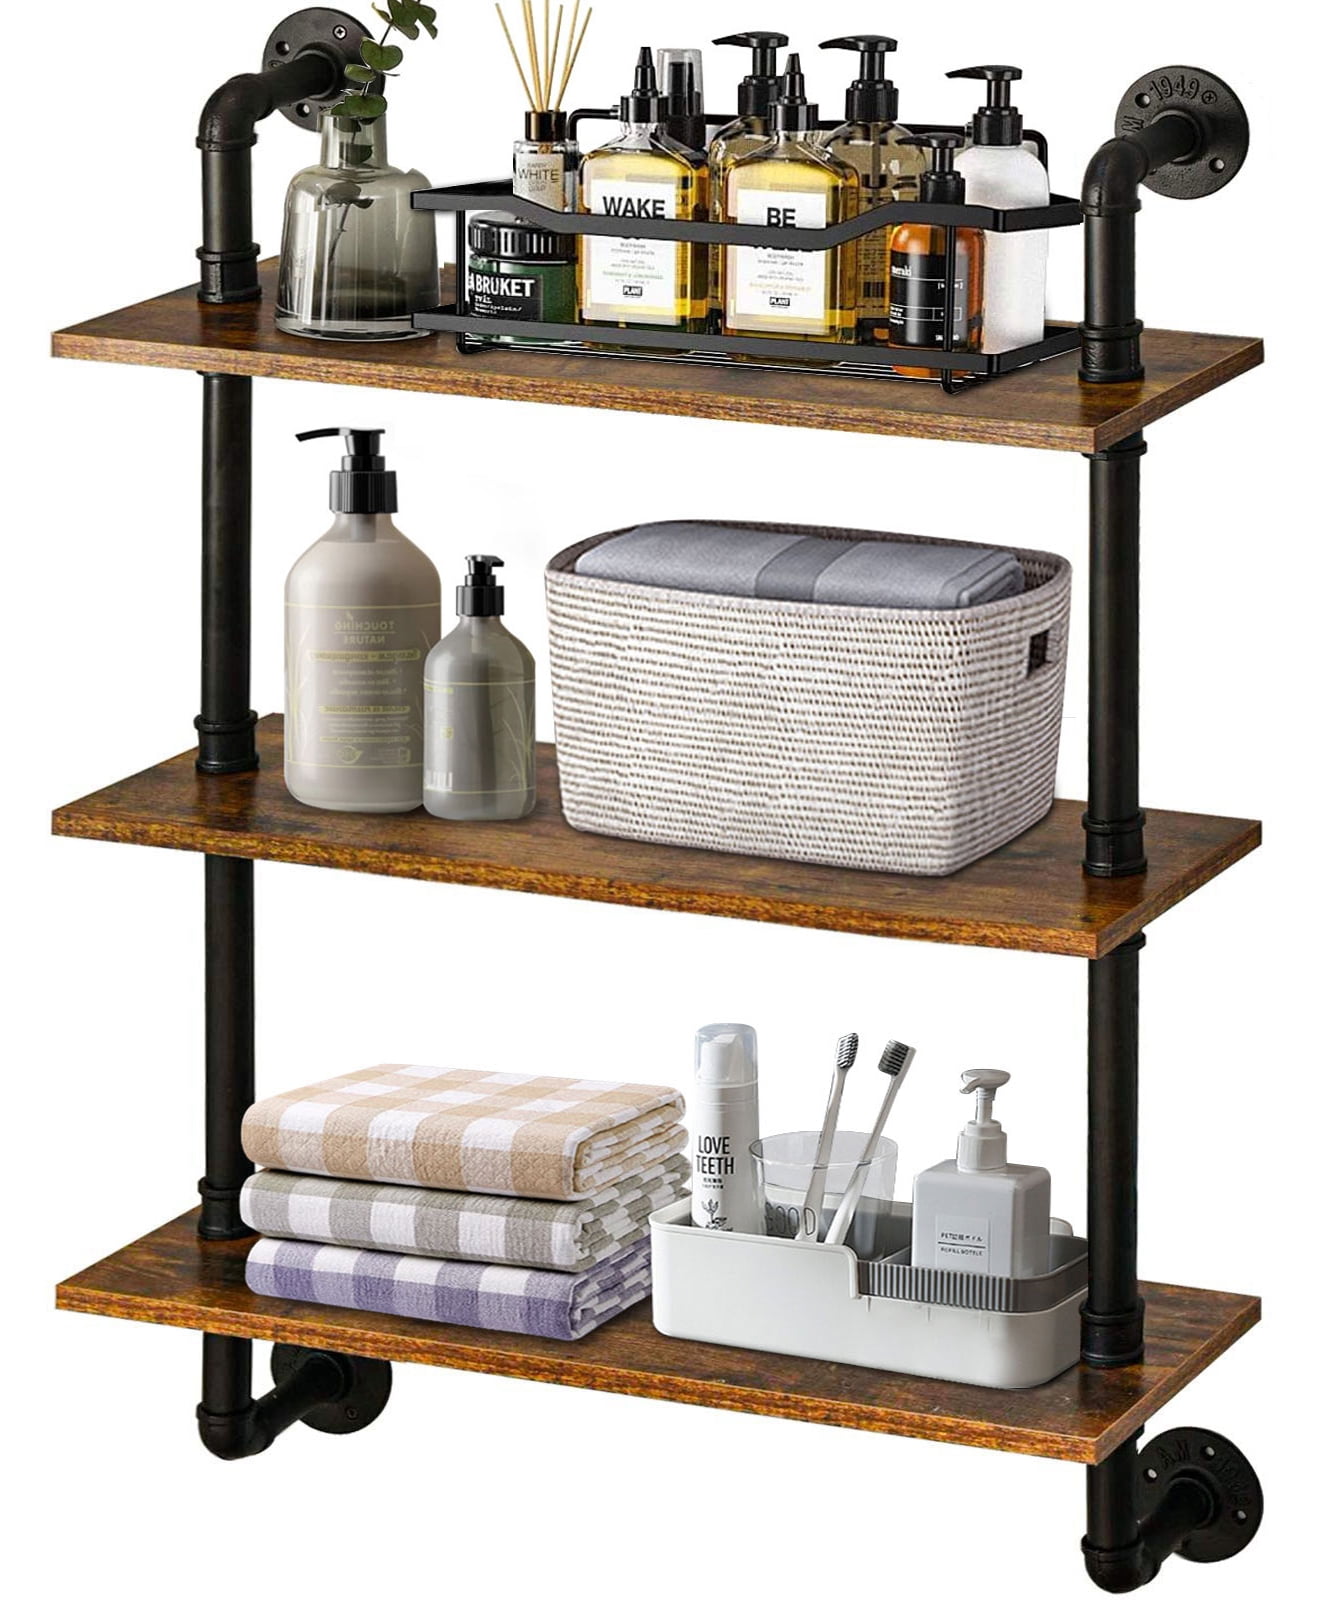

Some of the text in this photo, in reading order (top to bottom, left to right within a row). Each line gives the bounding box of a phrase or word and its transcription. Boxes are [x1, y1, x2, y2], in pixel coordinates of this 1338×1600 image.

[1149, 75, 1200, 101] 1949
[518, 168, 560, 181] WHITE
[602, 196, 665, 219] WAKE
[767, 207, 796, 229] BE
[475, 274, 535, 297] BRUKET
[698, 1135, 730, 1155] LOVE
[696, 1155, 734, 1175] TEETH
